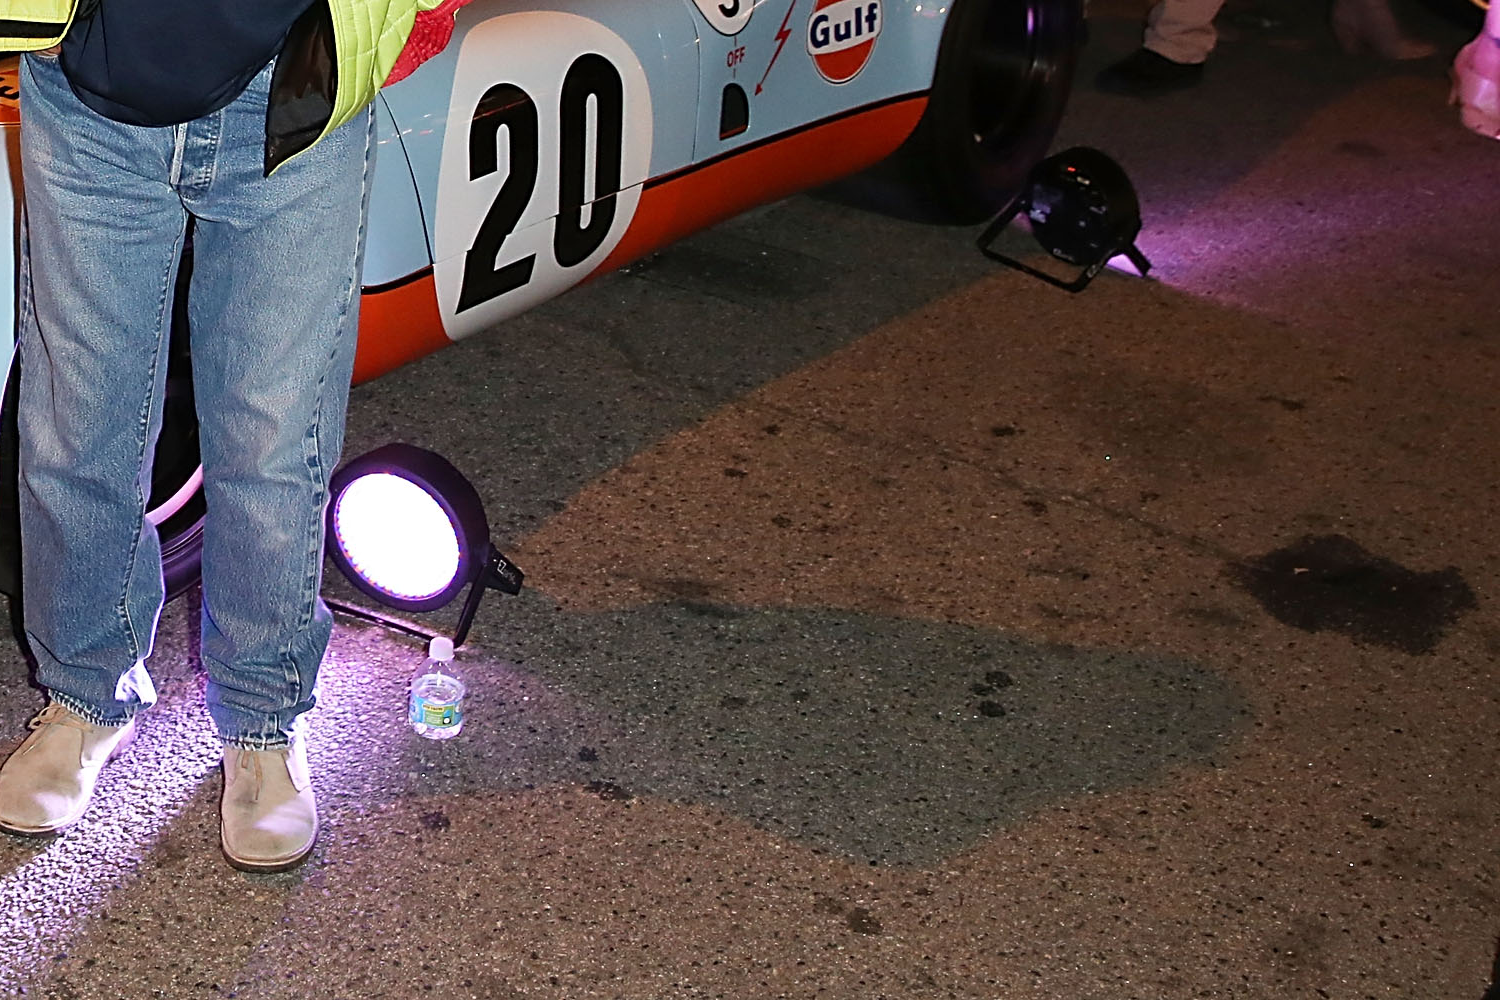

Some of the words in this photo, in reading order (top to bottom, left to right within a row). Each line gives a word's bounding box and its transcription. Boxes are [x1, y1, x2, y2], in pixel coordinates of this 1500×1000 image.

[810, 2, 878, 49] Gulf
[726, 47, 746, 67] OFF
[455, 53, 623, 315] 20
